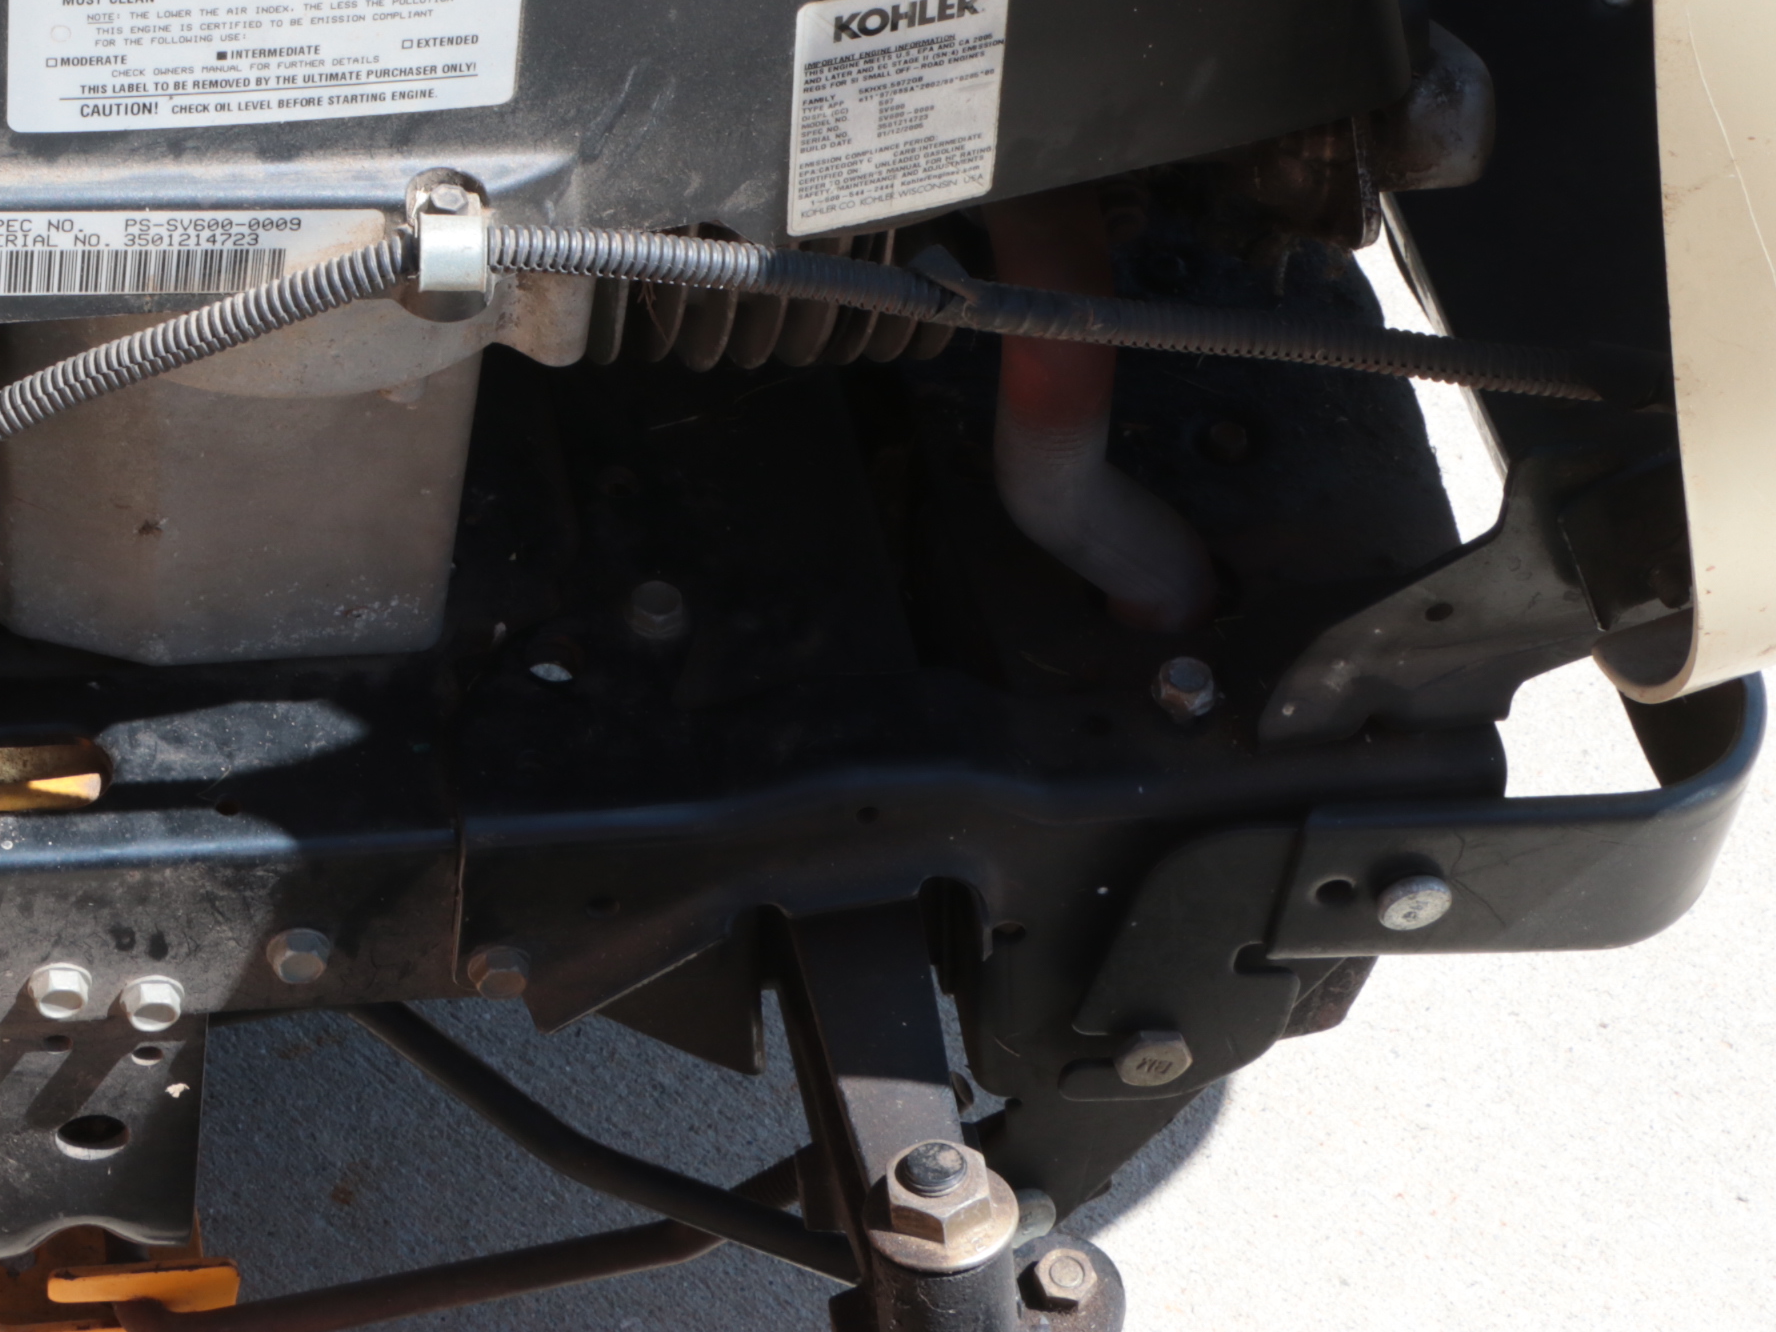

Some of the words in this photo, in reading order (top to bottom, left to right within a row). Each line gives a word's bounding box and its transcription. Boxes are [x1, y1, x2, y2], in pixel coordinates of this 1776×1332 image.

[87, 13, 120, 22] NOTE:
[130, 11, 149, 19] THE
[157, 10, 192, 19] LOWER
[200, 8, 219, 16] THE
[227, 7, 247, 15] AIR
[304, 3, 323, 11] THE
[330, 1, 357, 10] LESS
[365, 0, 385, 8] THE
[96, 27, 123, 36] THIS
[130, 25, 172, 34] ENGINE
[180, 24, 193, 32] IS
[200, 21, 262, 31] CERTIFIED
[290, 18, 303, 26] BE
[311, 14, 365, 25] EMISSION
[373, 9, 434, 21] COMPLIANT
[95, 39, 116, 47] FOR
[124, 37, 143, 46] THE
[151, 34, 213, 45] FOLLOWING
[220, 33, 247, 42] USE:
[417, 35, 478, 48] EXTENDED
[61, 55, 127, 67] MODERATE
[231, 44, 321, 60] INTERMEDIATE
[804, 54, 855, 70] IMPORTANT
[859, 47, 891, 59] ENGINE
[895, 34, 956, 52] INFORMATION
[804, 68, 825, 77] THIS
[828, 61, 860, 73] ENGINE
[938, 41, 955, 51] AND
[112, 69, 146, 78] CHECK
[153, 66, 194, 76] OWNERS
[202, 64, 242, 74] MANUAL
[250, 62, 270, 71] FOR
[278, 59, 325, 69] FURTHER
[332, 56, 380, 66] DETAILS
[80, 85, 107, 95] THIS
[112, 82, 148, 94] LABEL
[153, 81, 169, 91] TO
[174, 80, 188, 90] BE
[193, 77, 251, 90] REMOVED
[255, 76, 271, 86] BY
[276, 75, 298, 86] THE
[303, 71, 362, 84] ULTIMATE
[367, 65, 437, 80] PURCHASER
[442, 62, 476, 74] ONLY!
[80, 102, 159, 118] CAUTION!
[172, 102, 211, 115] CHECK
[215, 101, 233, 112] OIL
[238, 100, 273, 111] LEVEL
[278, 96, 323, 109] BEFORE
[328, 92, 386, 105] STARTING
[392, 88, 437, 101] ENGINE.
[48, 219, 85, 232] NO.
[124, 218, 301, 232] PS-SV600-0009
[74, 233, 110, 247] NO.
[124, 233, 259, 247] 3501214723
